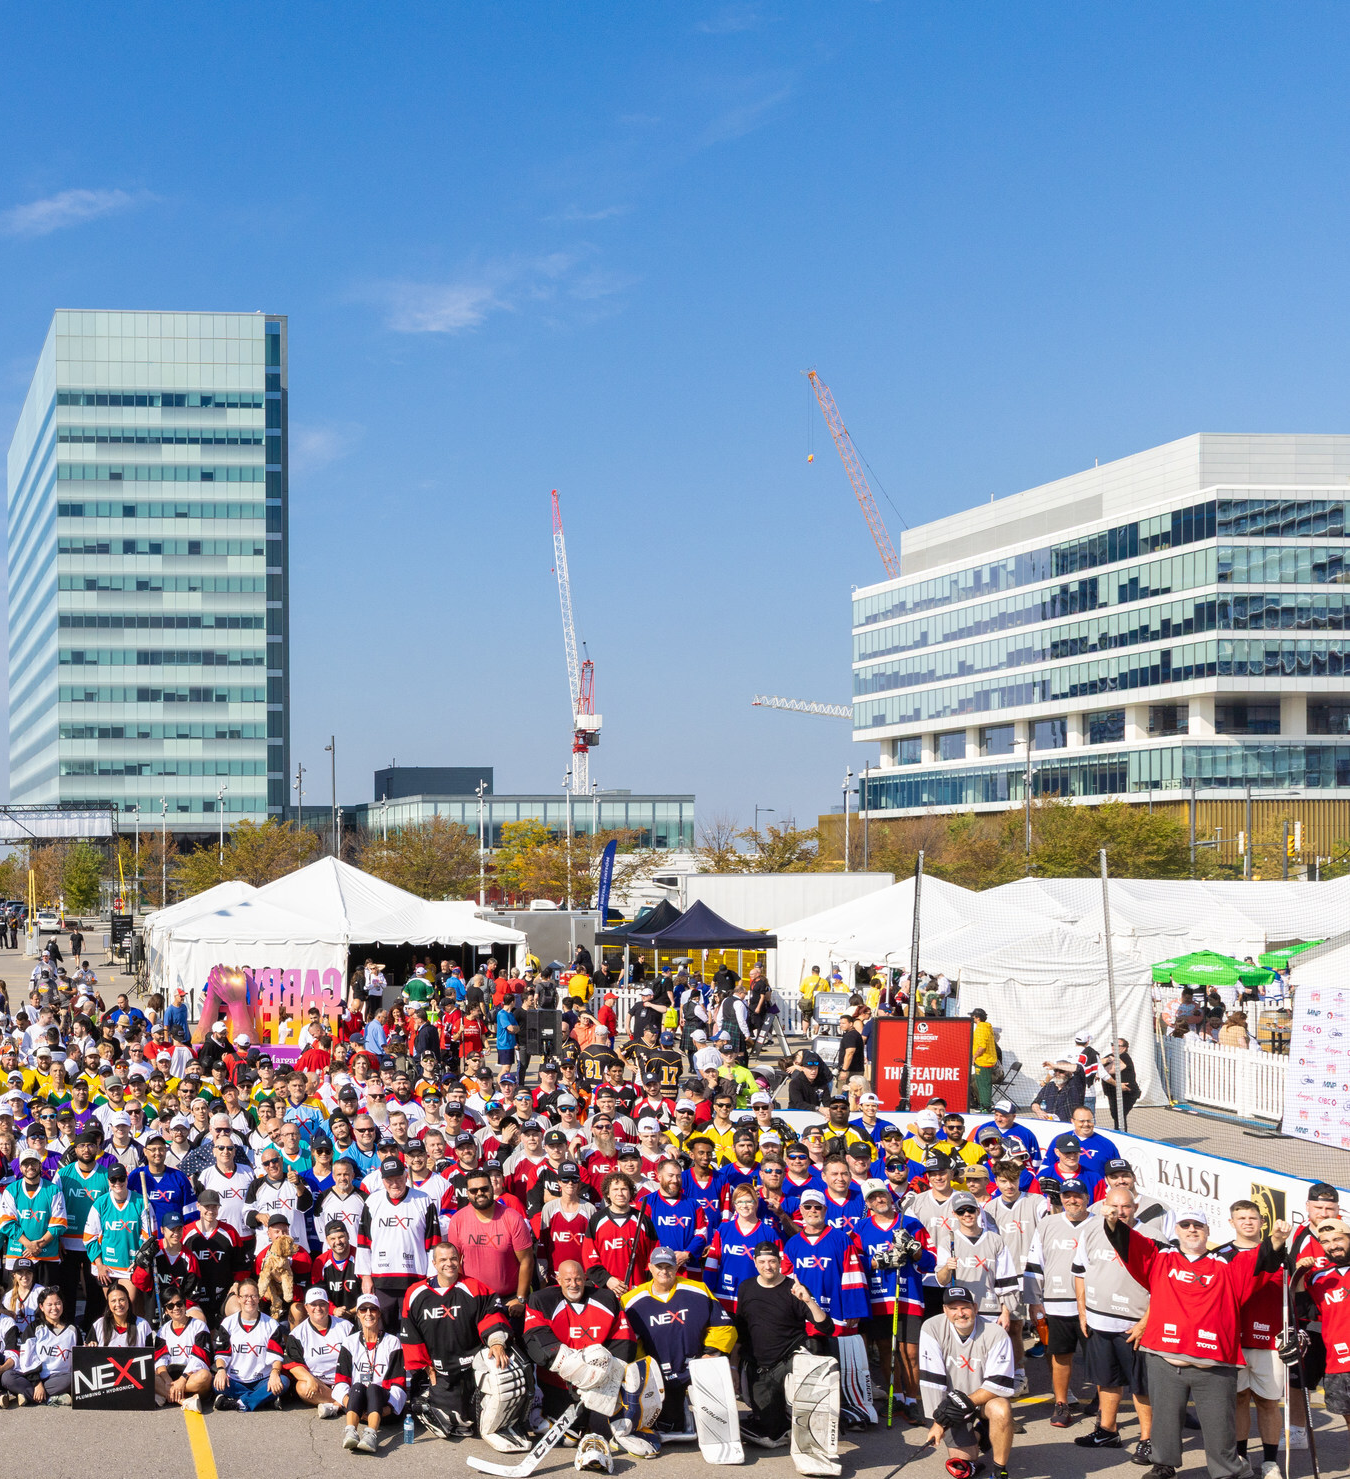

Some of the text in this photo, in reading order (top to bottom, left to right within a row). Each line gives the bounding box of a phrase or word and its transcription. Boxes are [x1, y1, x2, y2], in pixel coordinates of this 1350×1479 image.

[585, 1059, 603, 1080] 21
[661, 1066, 679, 1086] 17
[911, 1067, 960, 1081] FEATURE
[910, 1083, 934, 1096] PAD
[615, 1098, 631, 1108] EXT
[1157, 1158, 1220, 1201] KALSI
[69, 1188, 101, 1201] NEXT
[217, 1188, 248, 1200] NEXT
[266, 1198, 296, 1210] NEXT
[1164, 1192, 1221, 1216] ASSOCIATES
[17, 1208, 47, 1222] NEXT
[327, 1210, 359, 1225] NEXT
[379, 1215, 413, 1230] NEXT
[658, 1214, 691, 1228] NEXT
[105, 1219, 137, 1233] NEXT
[828, 1216, 861, 1230] NEXT
[999, 1220, 1030, 1234] NEXT
[468, 1232, 503, 1249] NEXT
[553, 1230, 585, 1245] NEXT
[192, 1248, 225, 1263] NEXT
[723, 1243, 755, 1260] NEX
[868, 1241, 894, 1255] NEX
[796, 1255, 832, 1271] NEXT
[957, 1255, 995, 1272] NEXT
[1094, 1249, 1123, 1268] NEX
[157, 1273, 184, 1287] NEXT
[1168, 1268, 1215, 1288] NEXT
[329, 1280, 356, 1292] NEXT
[423, 1305, 461, 1320] NEXT
[650, 1309, 688, 1326] NEXT
[1253, 1333, 1271, 1341] TOTO
[232, 1342, 266, 1357] NEXT
[1197, 1341, 1218, 1350] TOTO
[40, 1345, 71, 1362] NEXT
[354, 1361, 387, 1378] NEXT
[946, 1355, 981, 1373] NEXT
[73, 1354, 153, 1395] NEXT
[75, 1384, 135, 1400] PLUMBING HYDRONICS
[948, 1391, 967, 1409] UER
[701, 1405, 728, 1425] BAUER
[533, 1415, 570, 1460] CCM
